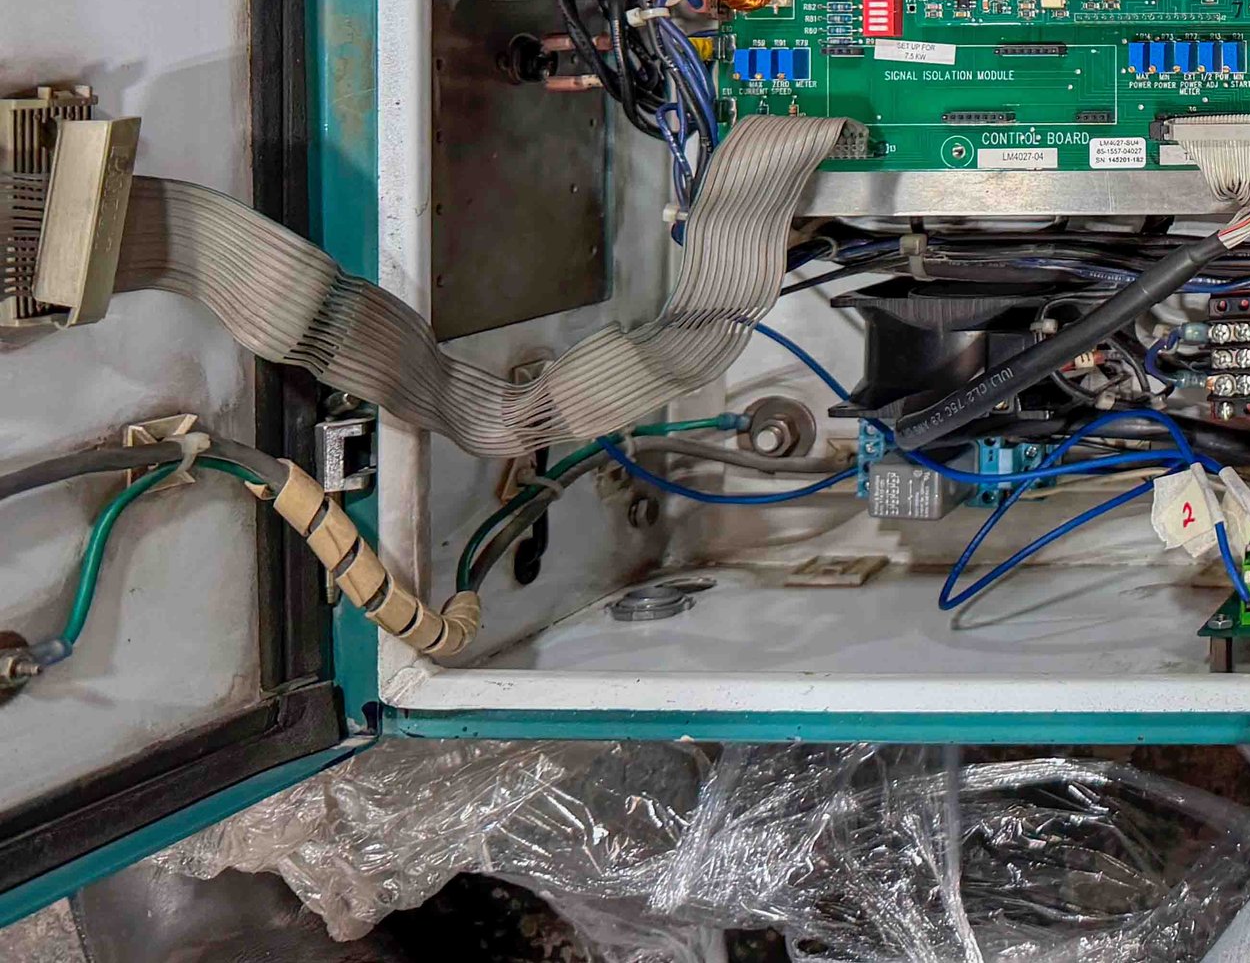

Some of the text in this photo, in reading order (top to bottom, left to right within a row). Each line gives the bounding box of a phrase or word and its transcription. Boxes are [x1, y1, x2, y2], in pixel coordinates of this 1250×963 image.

[921, 44, 936, 52] FOR
[884, 70, 1015, 81] SIGNAL ISOLATION MODULE
[1129, 81, 1152, 89] POWER
[1153, 81, 1177, 89] POWER
[981, 131, 1090, 145] CONTROL BOARD
[1002, 152, 1044, 162] LM4027-04
[966, 382, 988, 404] CL2
[944, 397, 965, 417] 75C
[1181, 501, 1196, 528] 2
